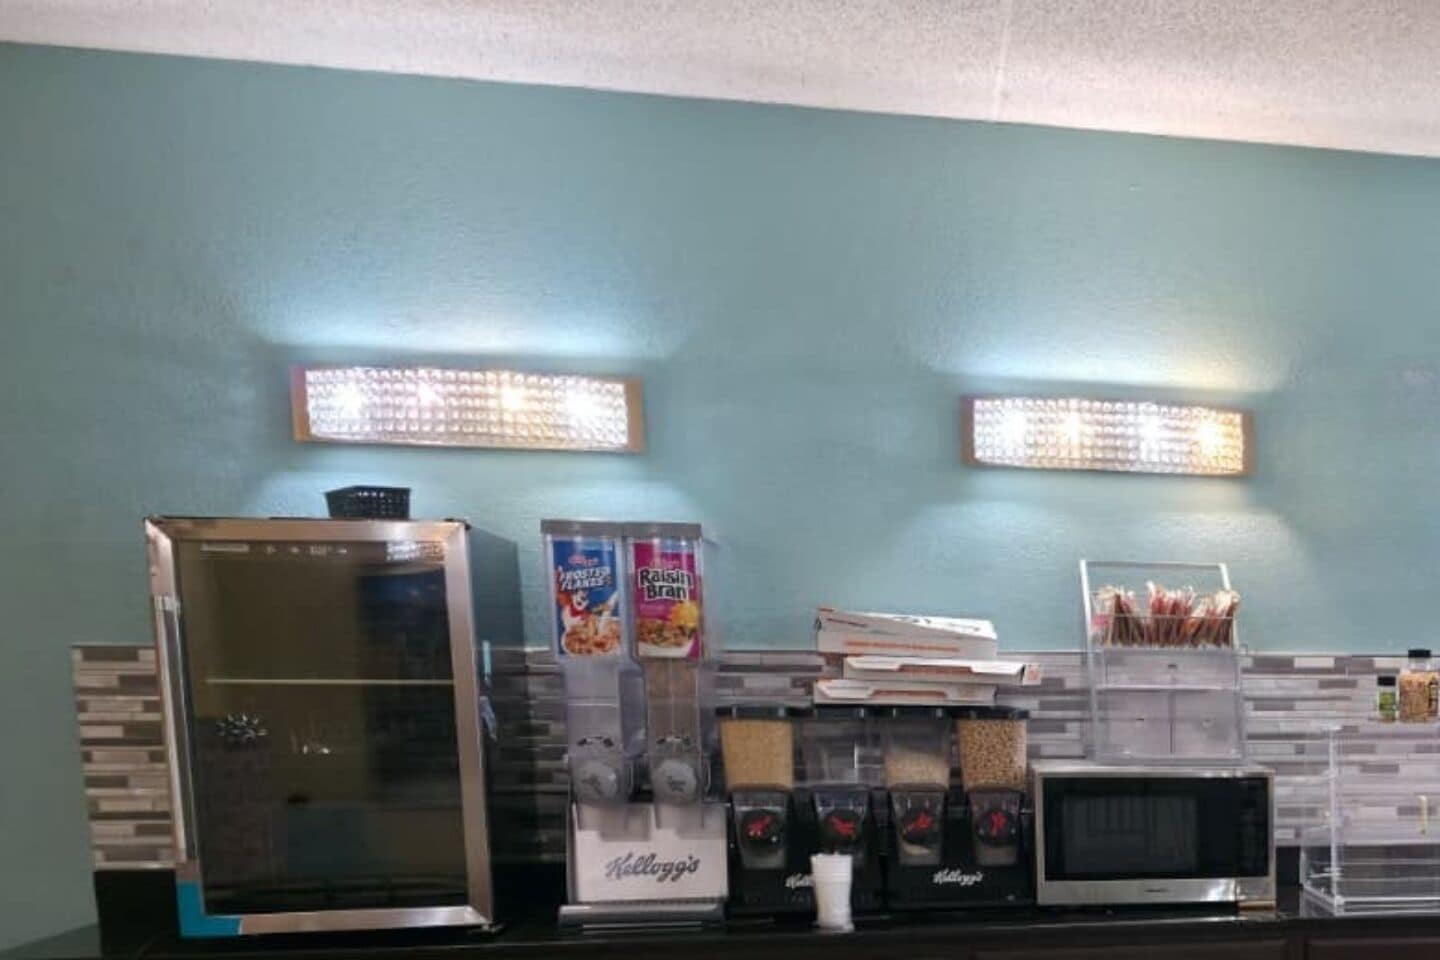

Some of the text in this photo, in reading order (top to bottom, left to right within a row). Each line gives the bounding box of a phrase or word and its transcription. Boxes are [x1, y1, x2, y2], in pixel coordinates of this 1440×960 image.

[639, 568, 692, 586] Raisin
[647, 585, 687, 599] Bran
[605, 852, 700, 882] Kellogg's
[933, 868, 983, 886] Kellogg's
